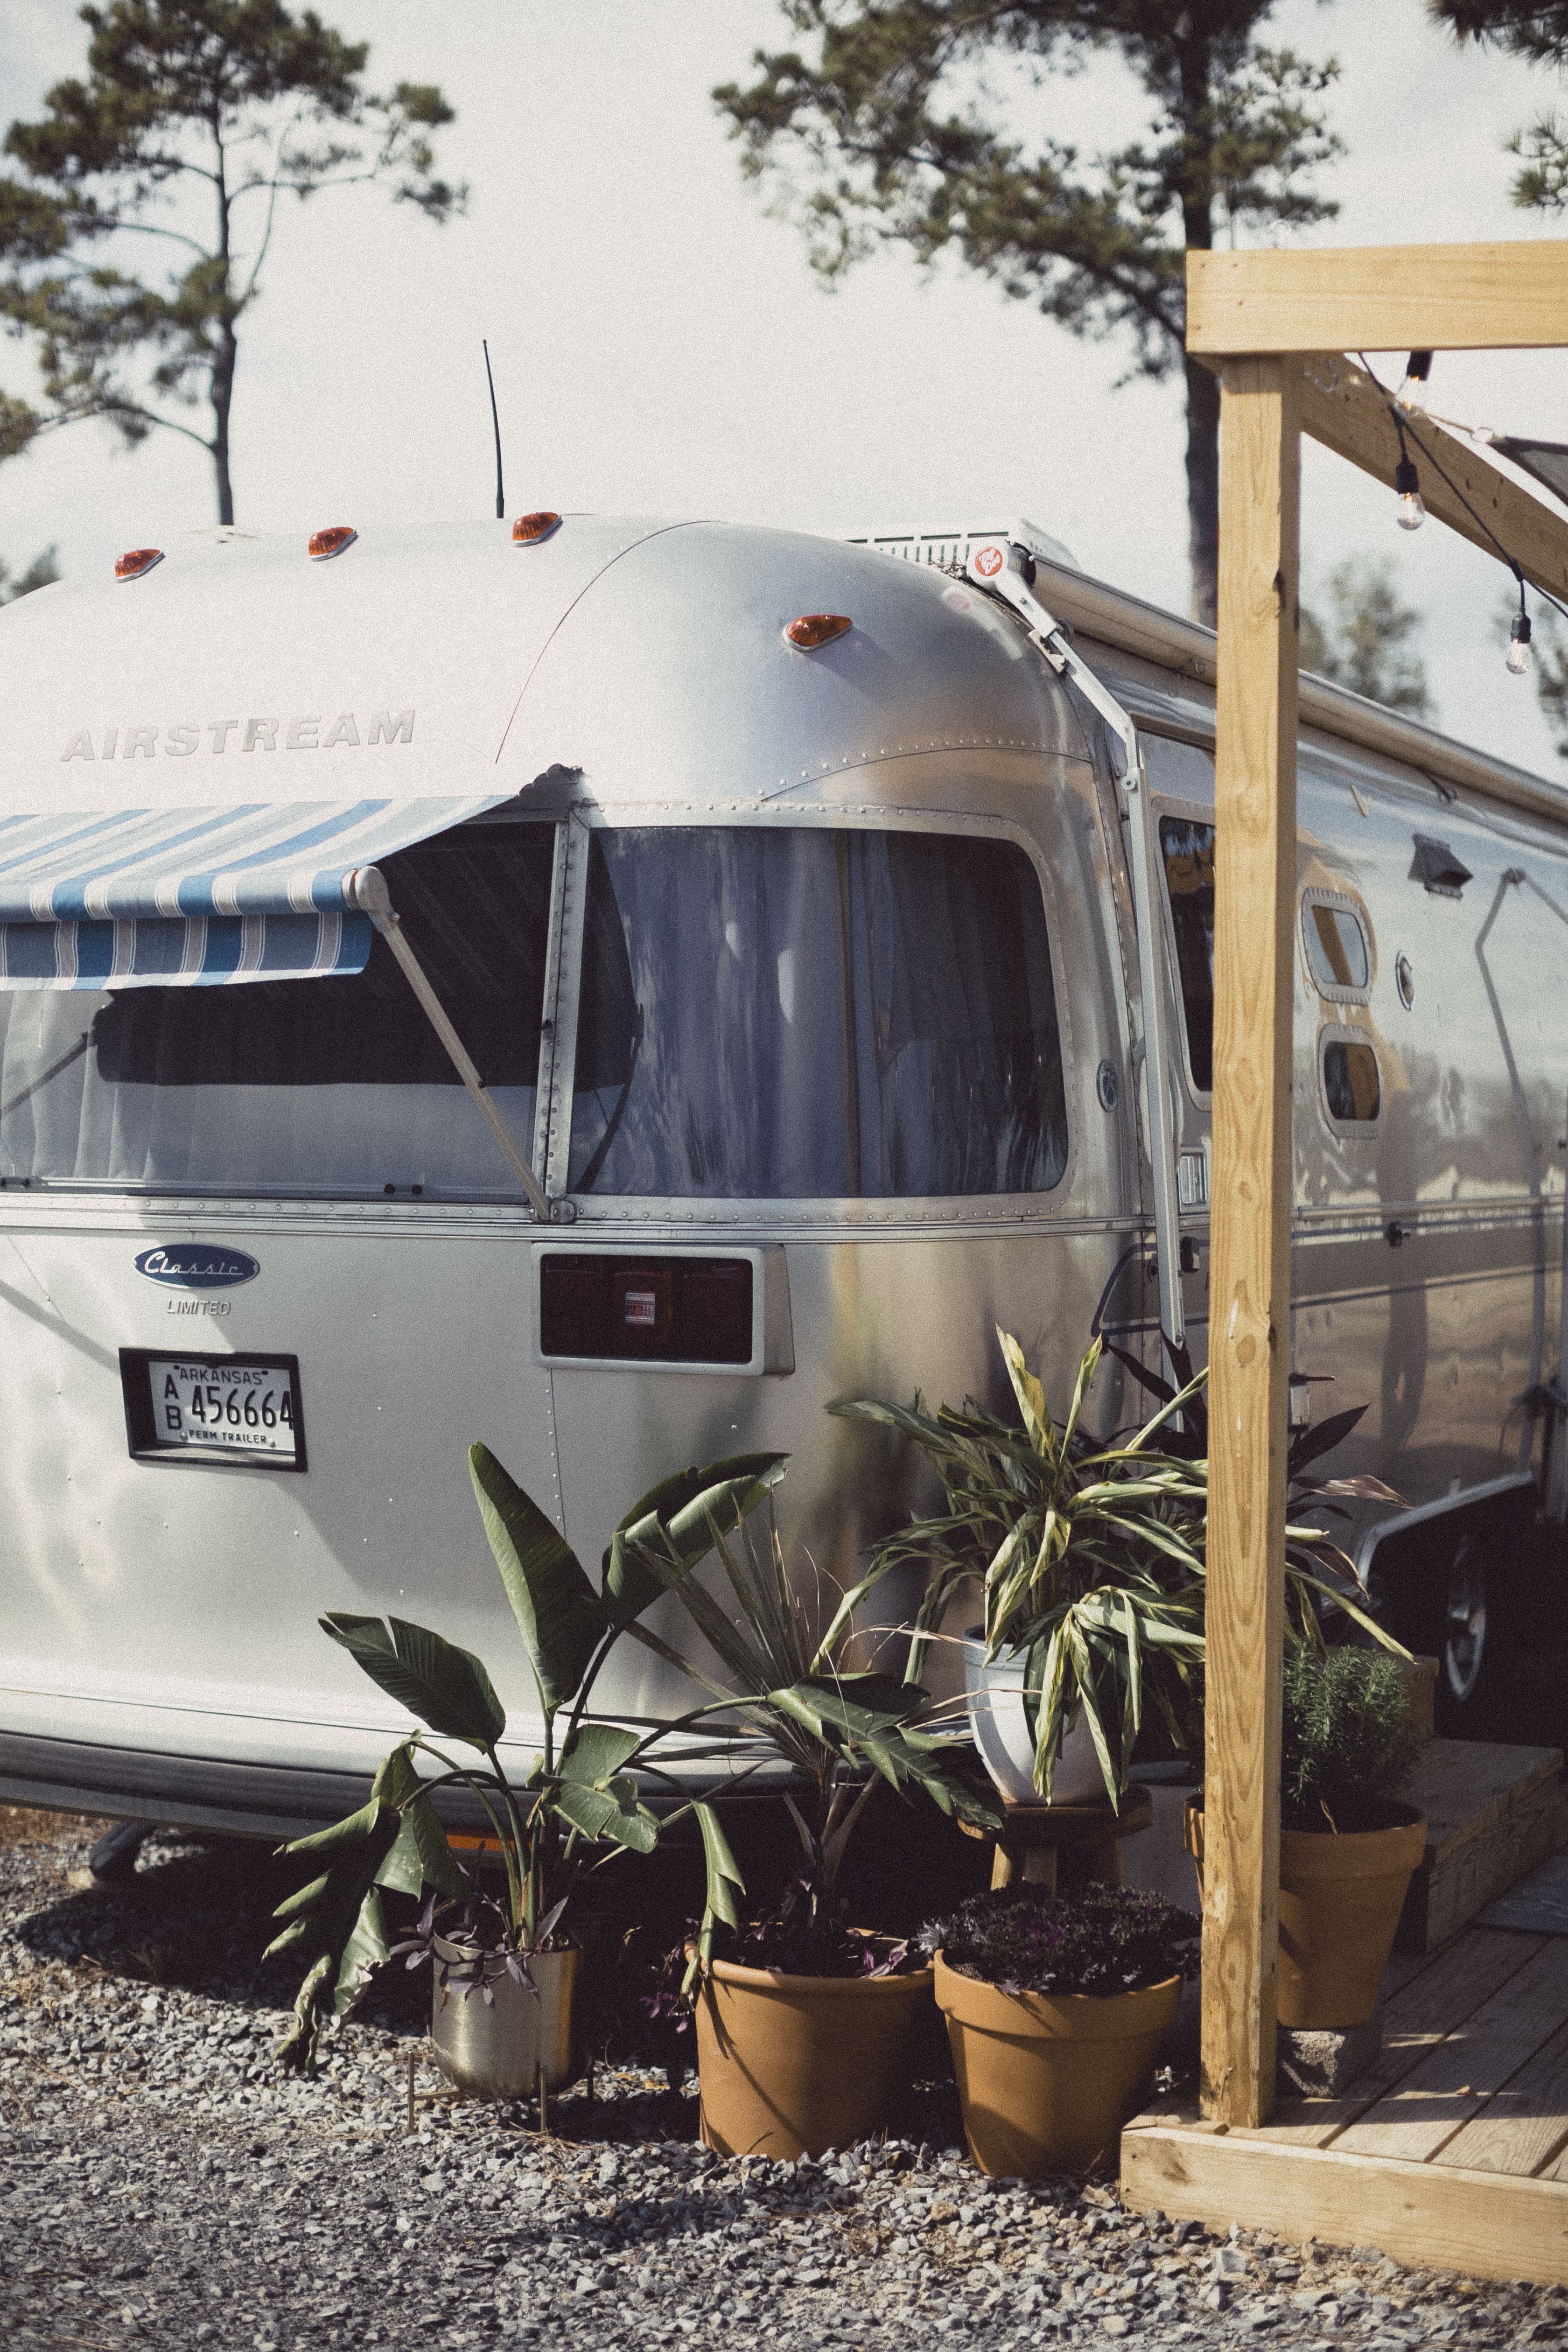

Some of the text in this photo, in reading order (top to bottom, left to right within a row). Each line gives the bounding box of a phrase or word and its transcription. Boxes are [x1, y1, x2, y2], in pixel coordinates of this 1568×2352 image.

[59, 708, 415, 762] AIRSTREAM
[144, 1251, 243, 1275] Classic
[167, 1300, 231, 1316] LIMITED
[180, 1368, 263, 1385] ARKANSAS
[192, 1385, 294, 1430] 456664
[189, 1429, 266, 1443] PERM TRAILER
